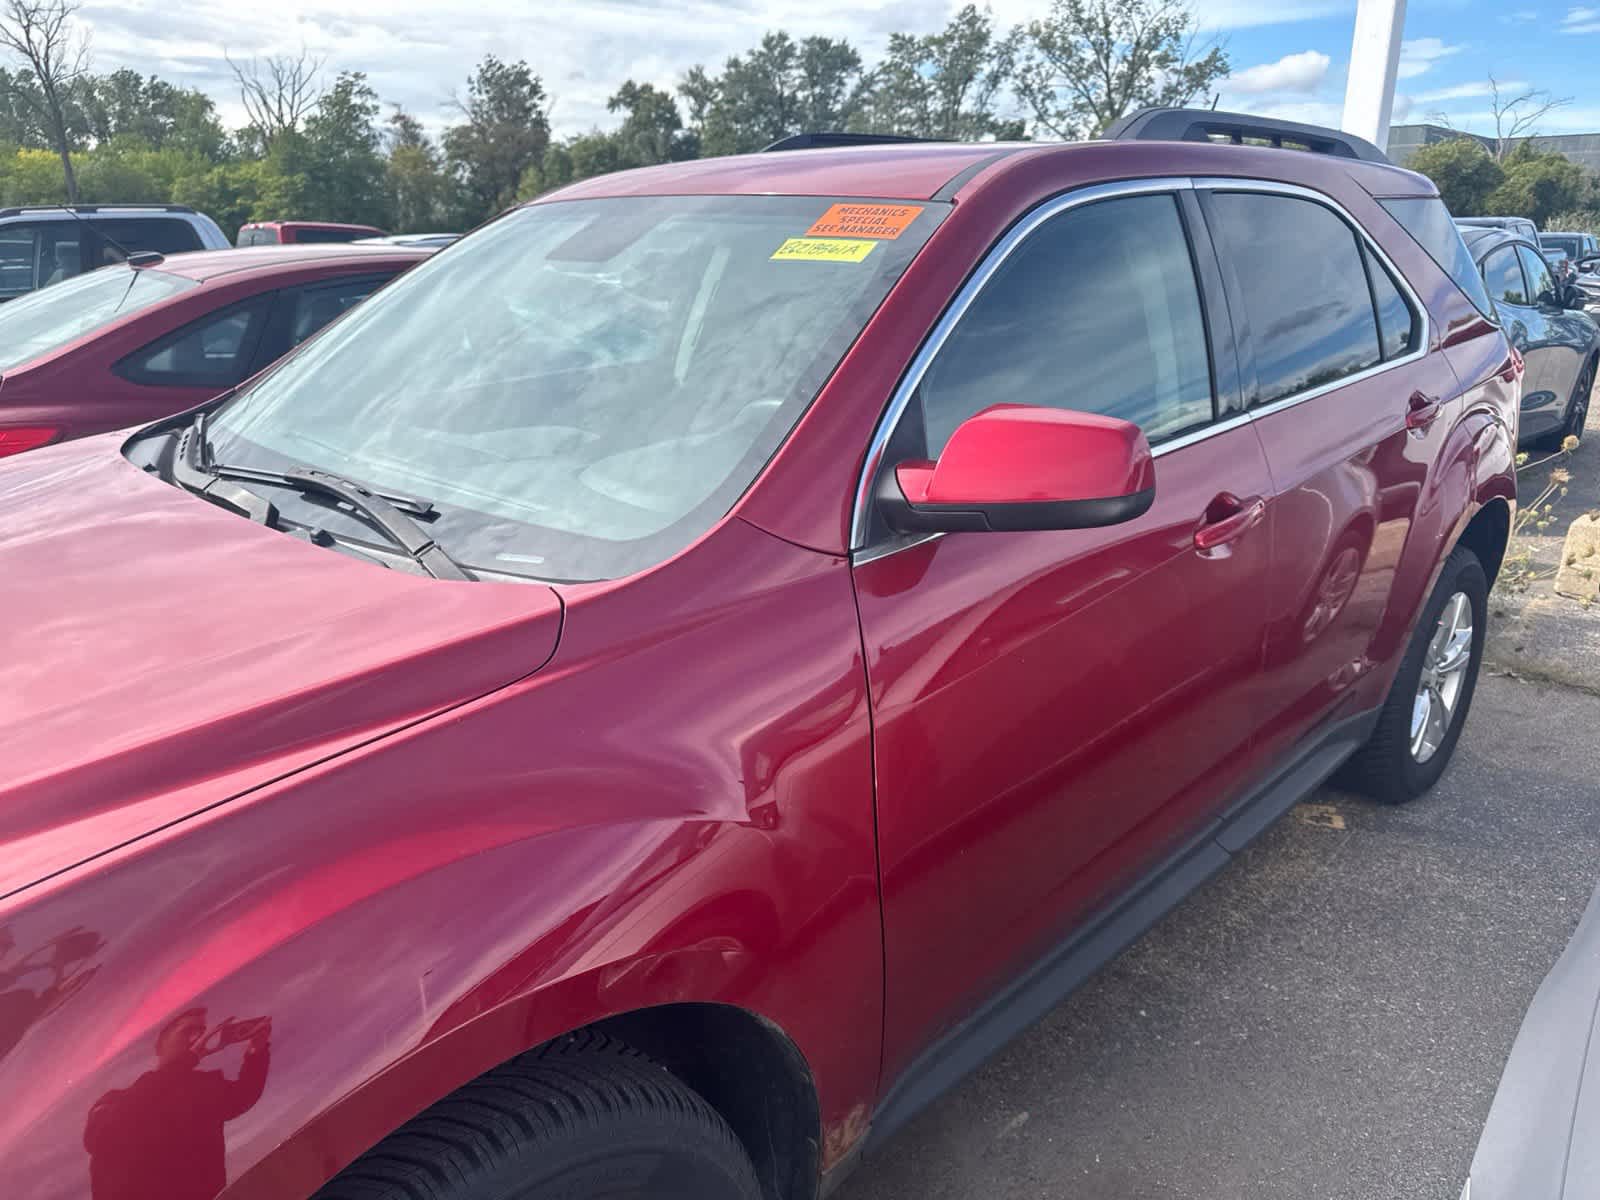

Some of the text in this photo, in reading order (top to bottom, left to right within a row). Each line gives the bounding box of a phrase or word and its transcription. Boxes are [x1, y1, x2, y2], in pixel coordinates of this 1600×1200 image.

[839, 207, 910, 217] MECHANICS
[840, 216, 889, 226] SPECIAL
[814, 224, 899, 236] SEE MANAGER
